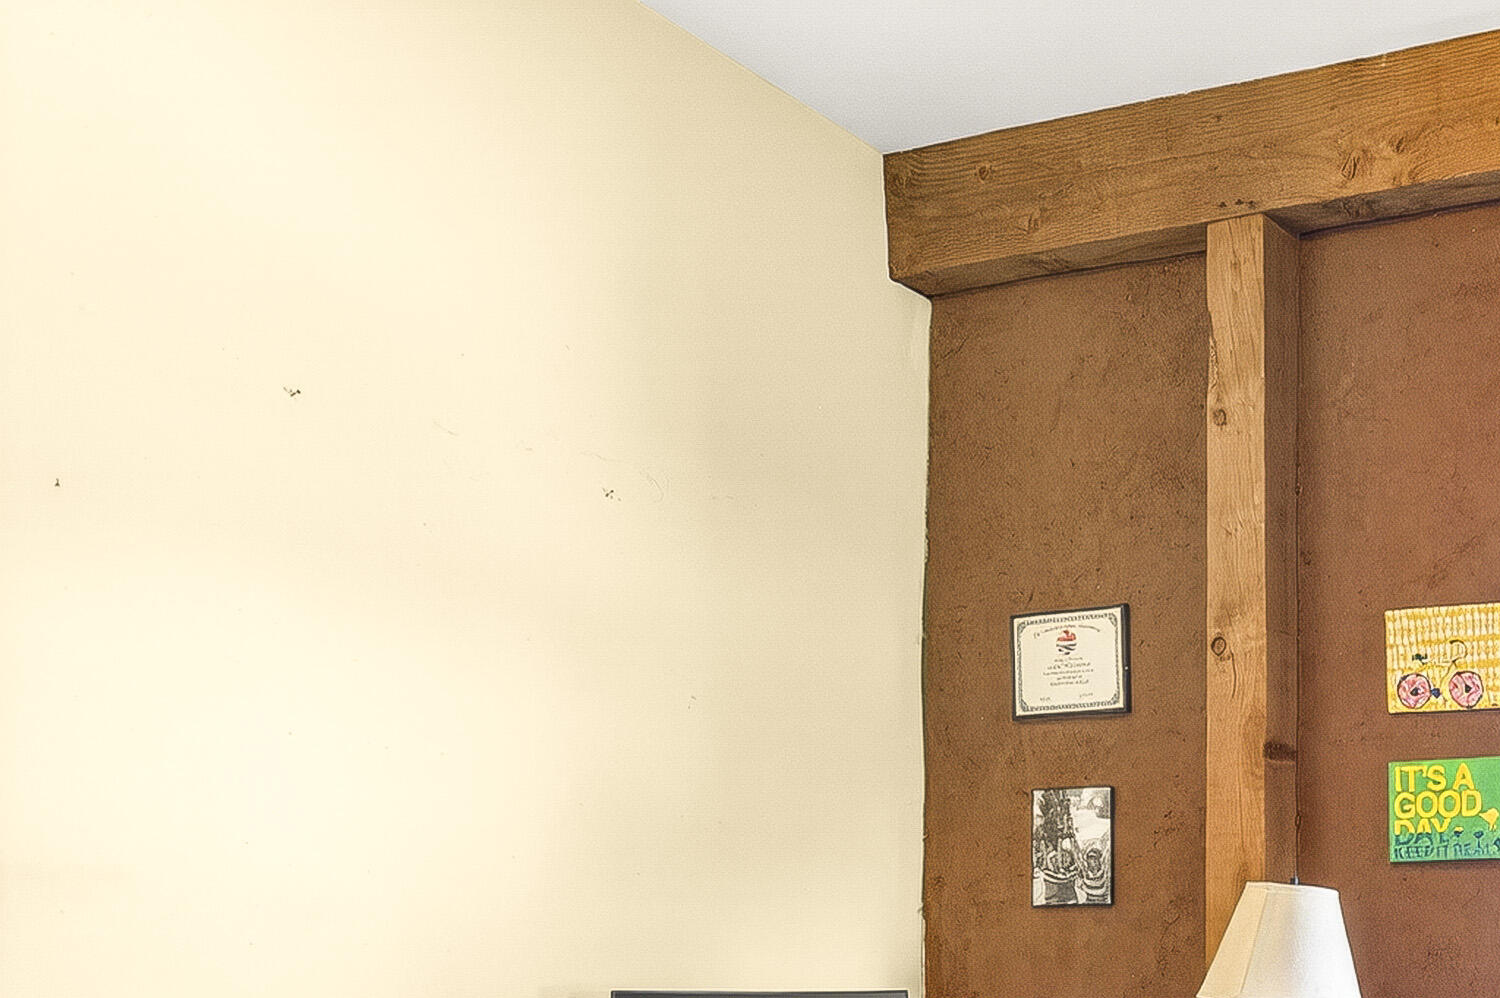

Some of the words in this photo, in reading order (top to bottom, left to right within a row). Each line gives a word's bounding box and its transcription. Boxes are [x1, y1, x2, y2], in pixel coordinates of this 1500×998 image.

[1394, 765, 1447, 792] IT'S
[1454, 762, 1475, 790] A
[1394, 789, 1482, 819] GOOD
[1394, 816, 1452, 846] DAY
[1393, 845, 1435, 860] KEEP
